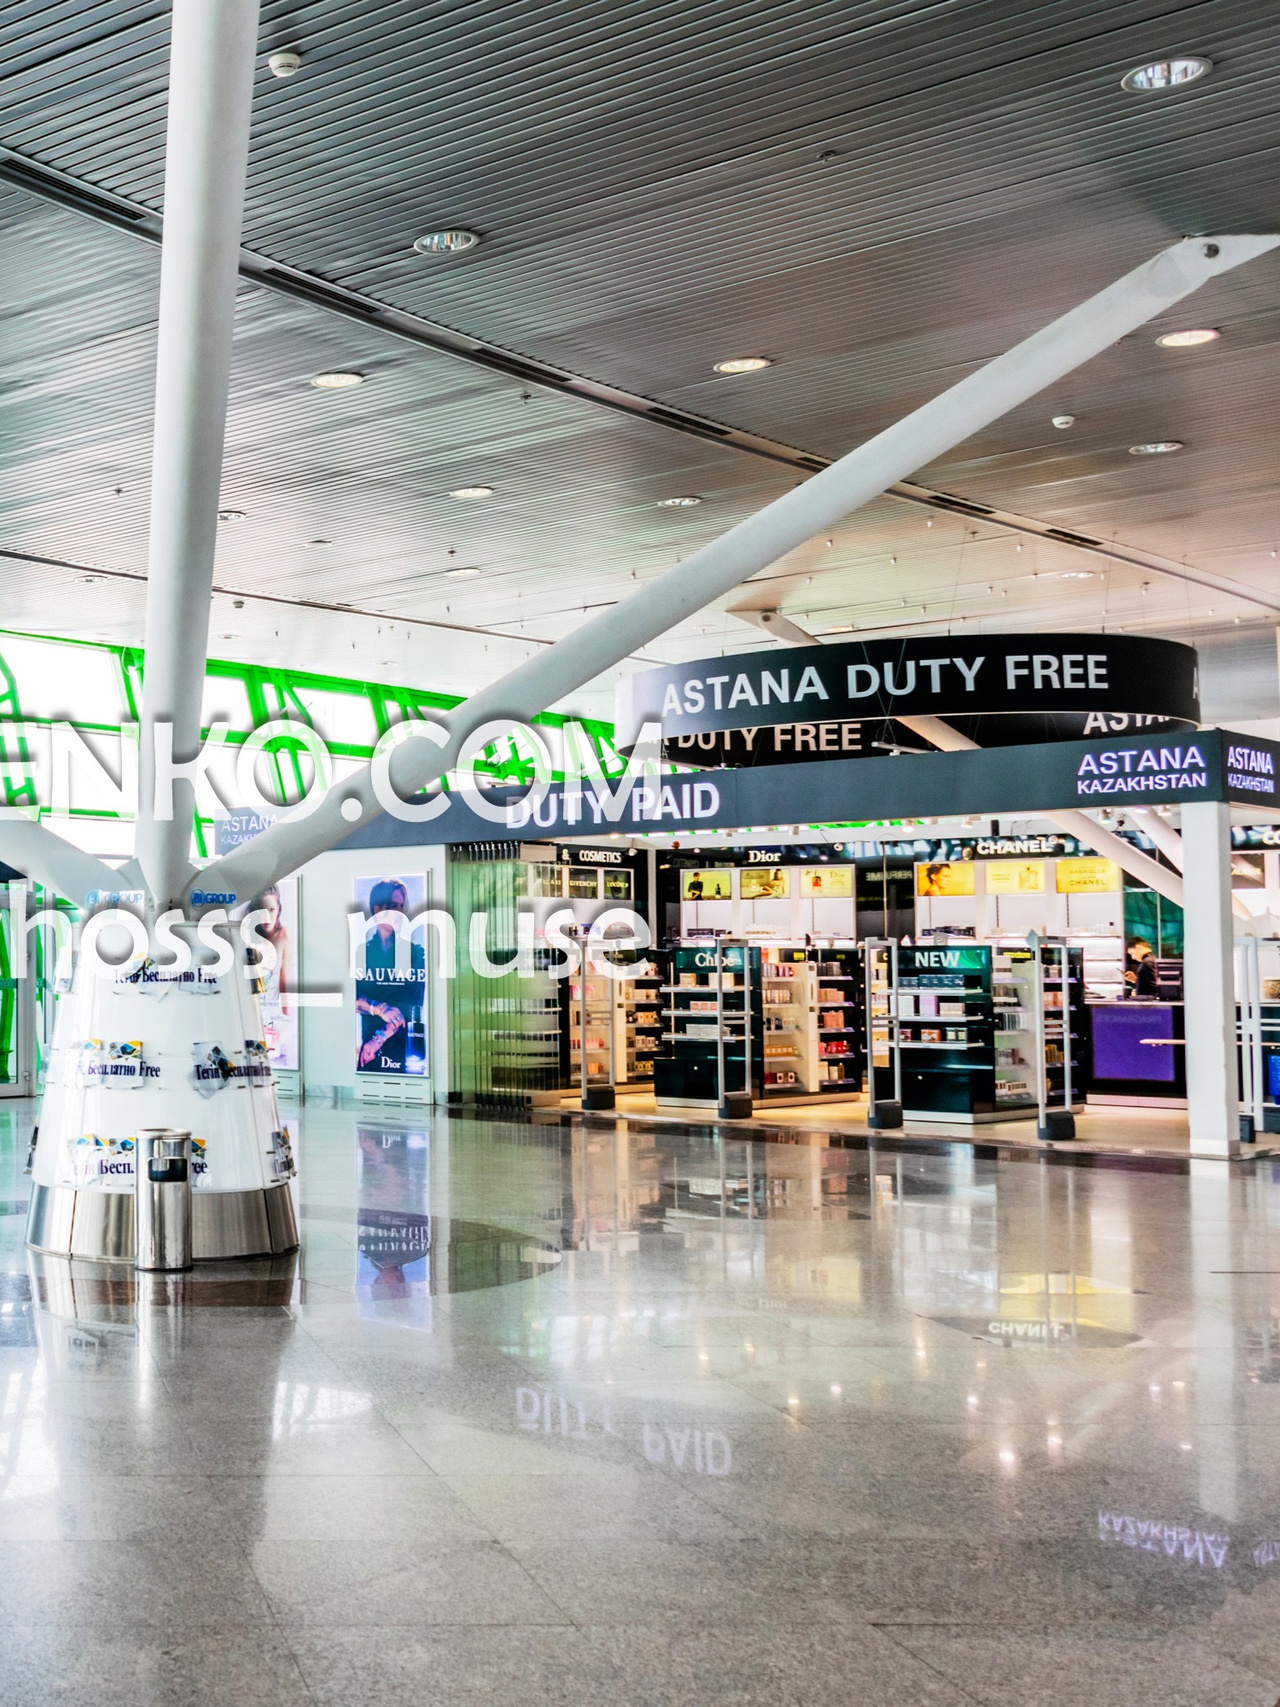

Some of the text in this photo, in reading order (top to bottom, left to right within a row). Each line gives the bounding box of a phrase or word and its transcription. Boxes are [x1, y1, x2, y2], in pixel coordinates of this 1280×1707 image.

[662, 654, 1110, 718] ASTANA DUTY FREE
[775, 723, 862, 751] FREE
[1077, 746, 1206, 776] ASTANA
[1227, 746, 1274, 775] ASTANA
[1077, 772, 1207, 794] KAZAKHSTAN
[1227, 773, 1275, 793] KAZAKHSTAN
[506, 782, 720, 829] DUTY PAID
[977, 839, 1052, 855] CHANEL
[579, 850, 622, 863] COSMETICS
[748, 850, 782, 863] Dior
[914, 951, 960, 967] NEW
[355, 967, 426, 982] SAUVAGE
[139, 1061, 161, 1078] Free
[381, 1056, 401, 1069] Dior
[191, 1160, 207, 1174] ree
